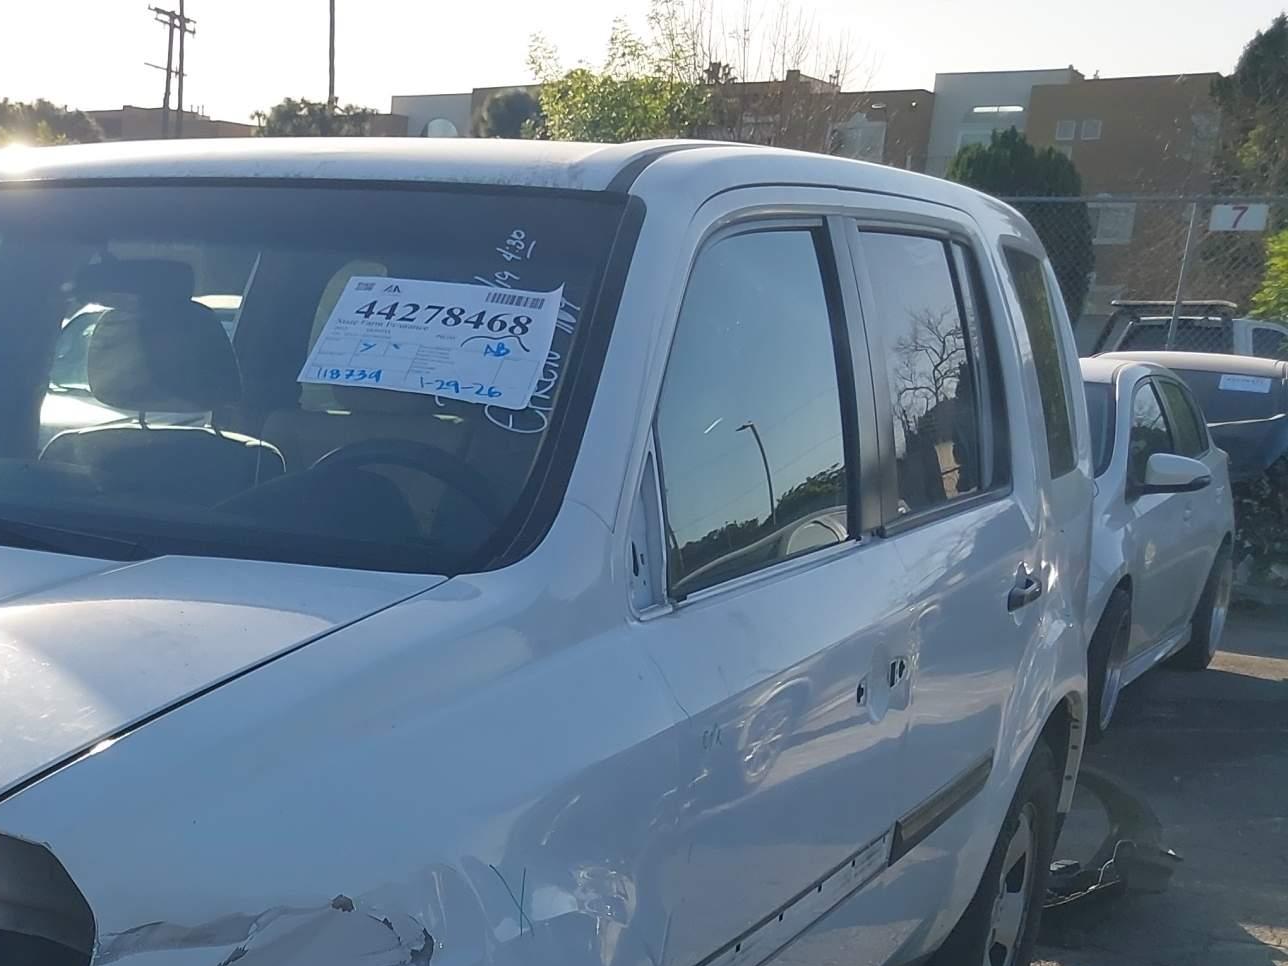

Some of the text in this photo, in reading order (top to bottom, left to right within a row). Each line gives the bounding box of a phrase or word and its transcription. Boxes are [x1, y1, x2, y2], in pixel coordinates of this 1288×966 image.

[1232, 206, 1248, 229] 7
[495, 229, 526, 260] 4:30
[355, 300, 533, 336] 44278468
[420, 376, 502, 398] 1-29-26
